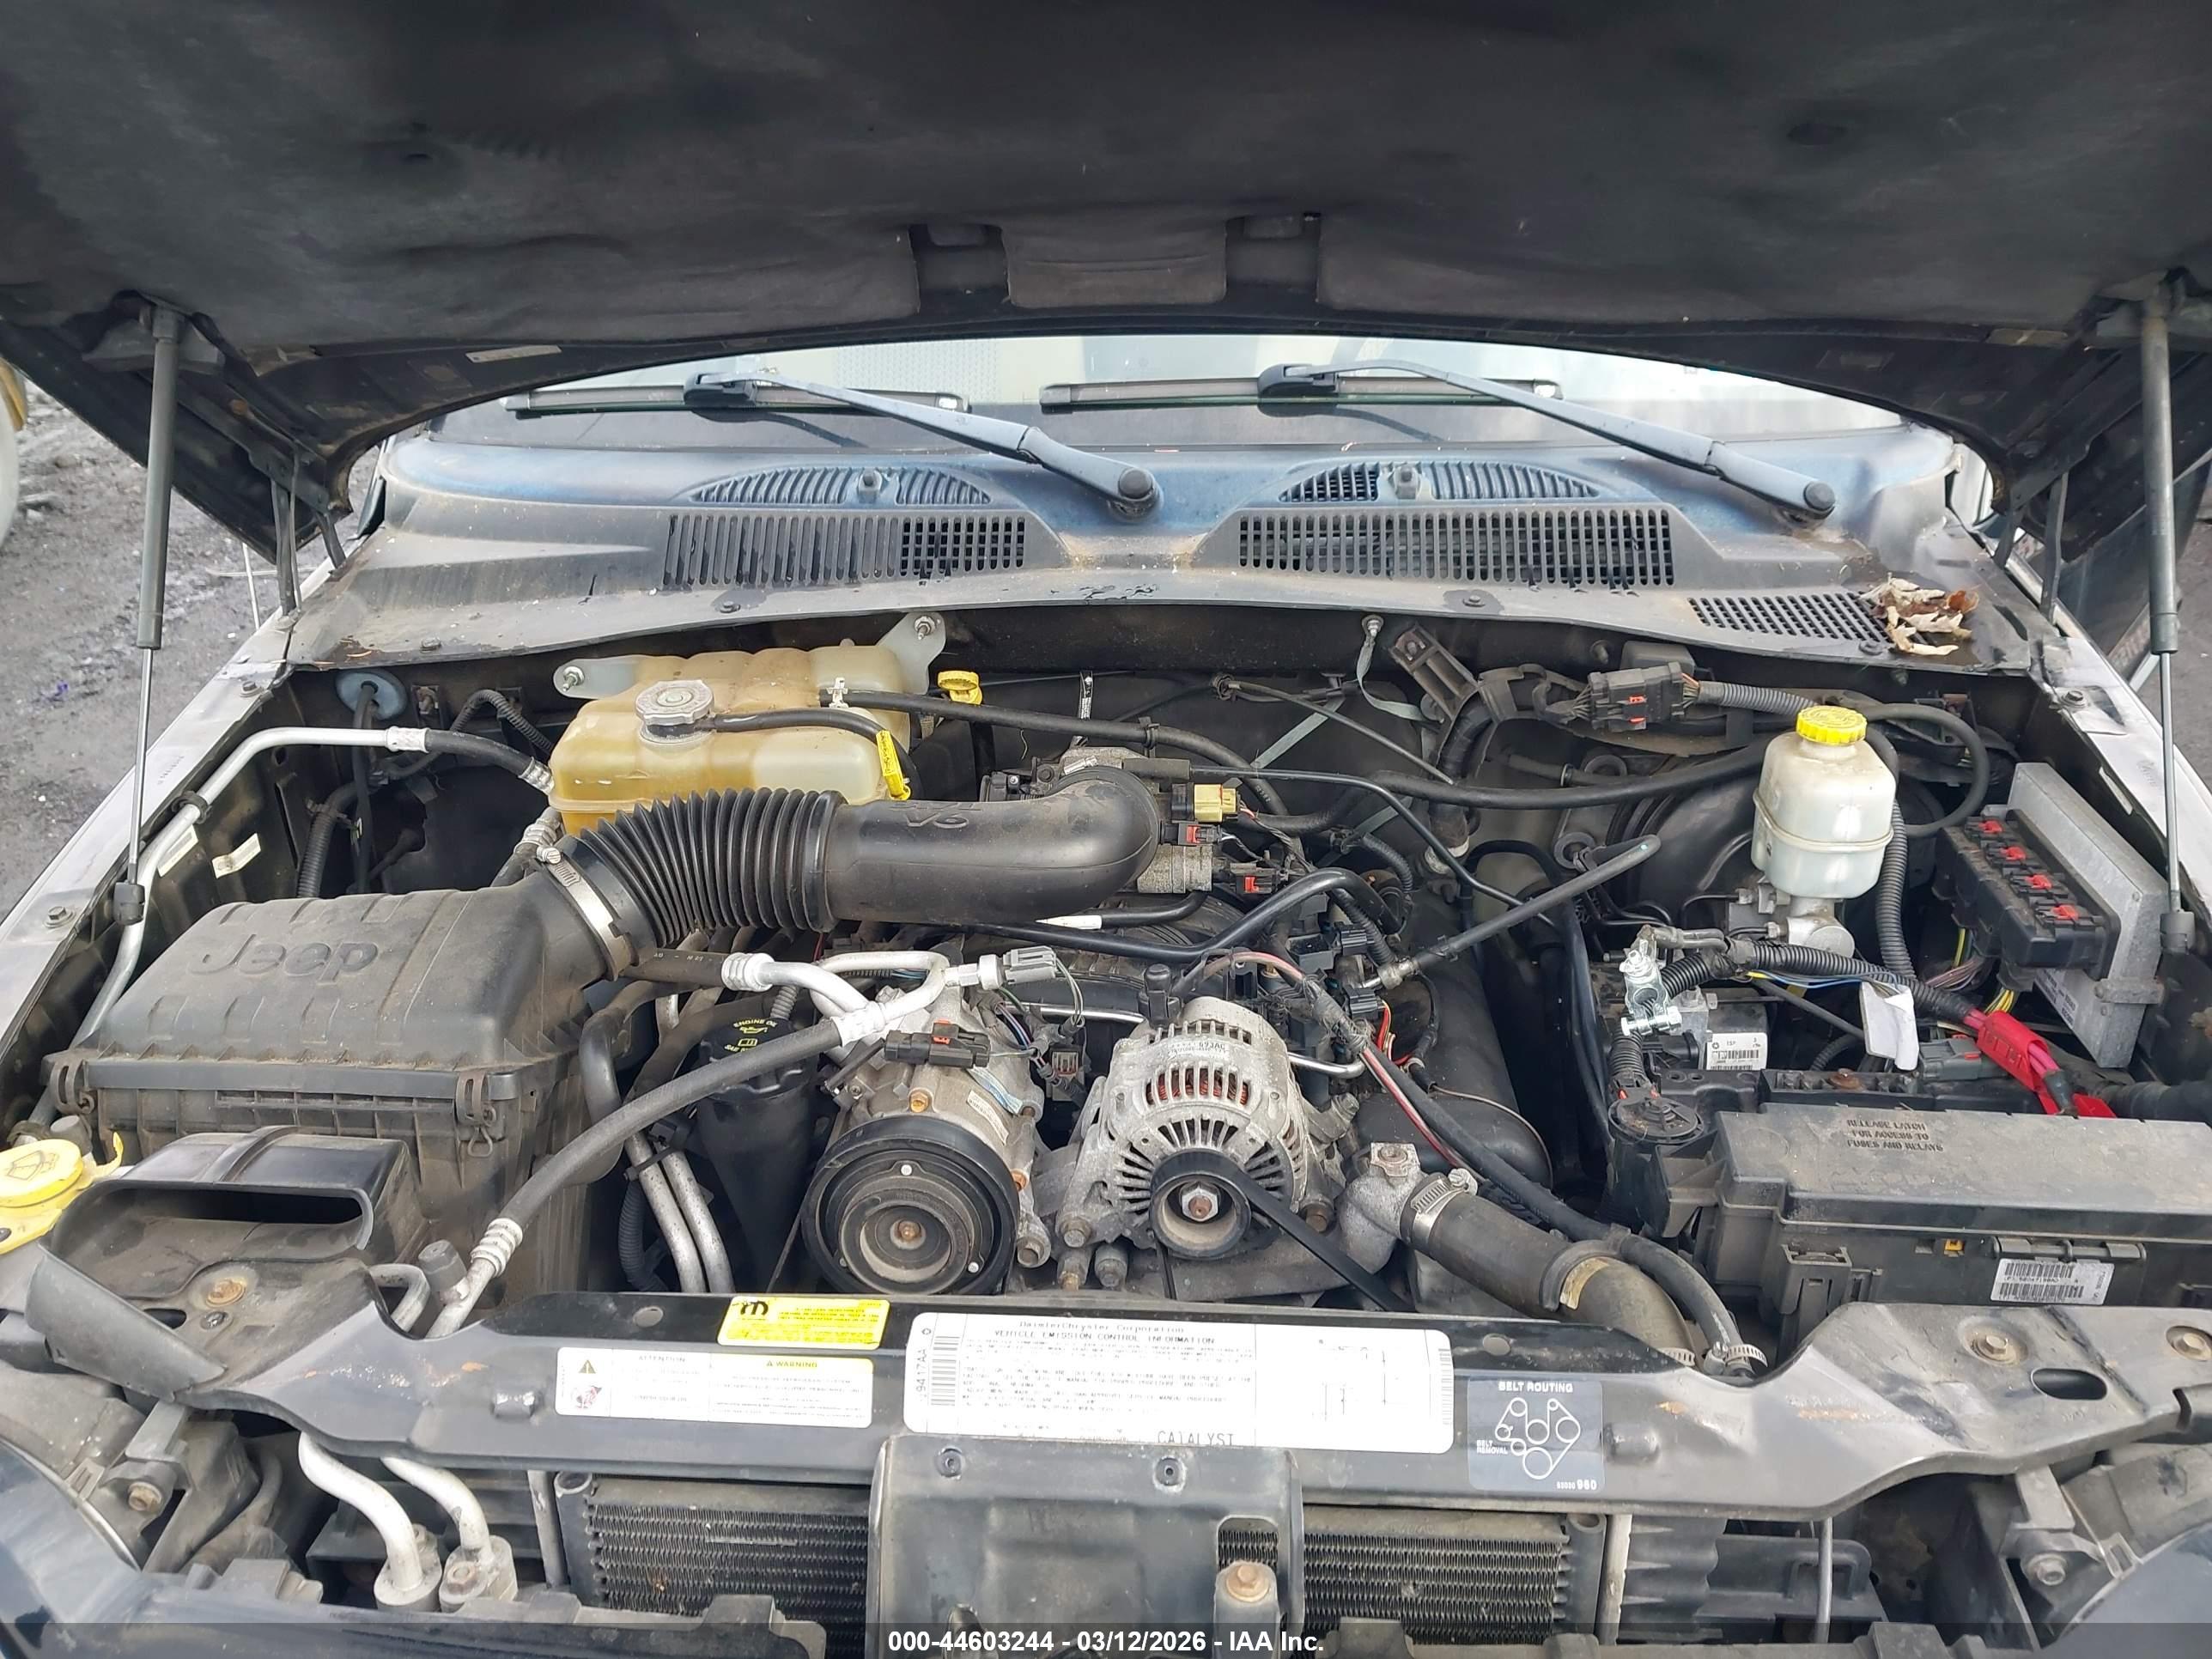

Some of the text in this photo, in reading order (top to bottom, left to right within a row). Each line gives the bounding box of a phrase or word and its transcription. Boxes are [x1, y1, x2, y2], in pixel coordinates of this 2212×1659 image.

[185, 933, 379, 985] Jeep
[1847, 1120, 1926, 1130] RELEASE LATCH
[1851, 1130, 1929, 1141] FOR ACCESS TO
[1847, 1139, 1944, 1152] FUSES AND RELAYS
[1042, 1331, 1092, 1340] EMISSION
[1148, 1335, 1215, 1344] INFORMATION
[775, 1360, 817, 1369] WARNING
[1498, 1381, 1573, 1393] BELT ROUTING
[1476, 1446, 1509, 1455] REMOVAL
